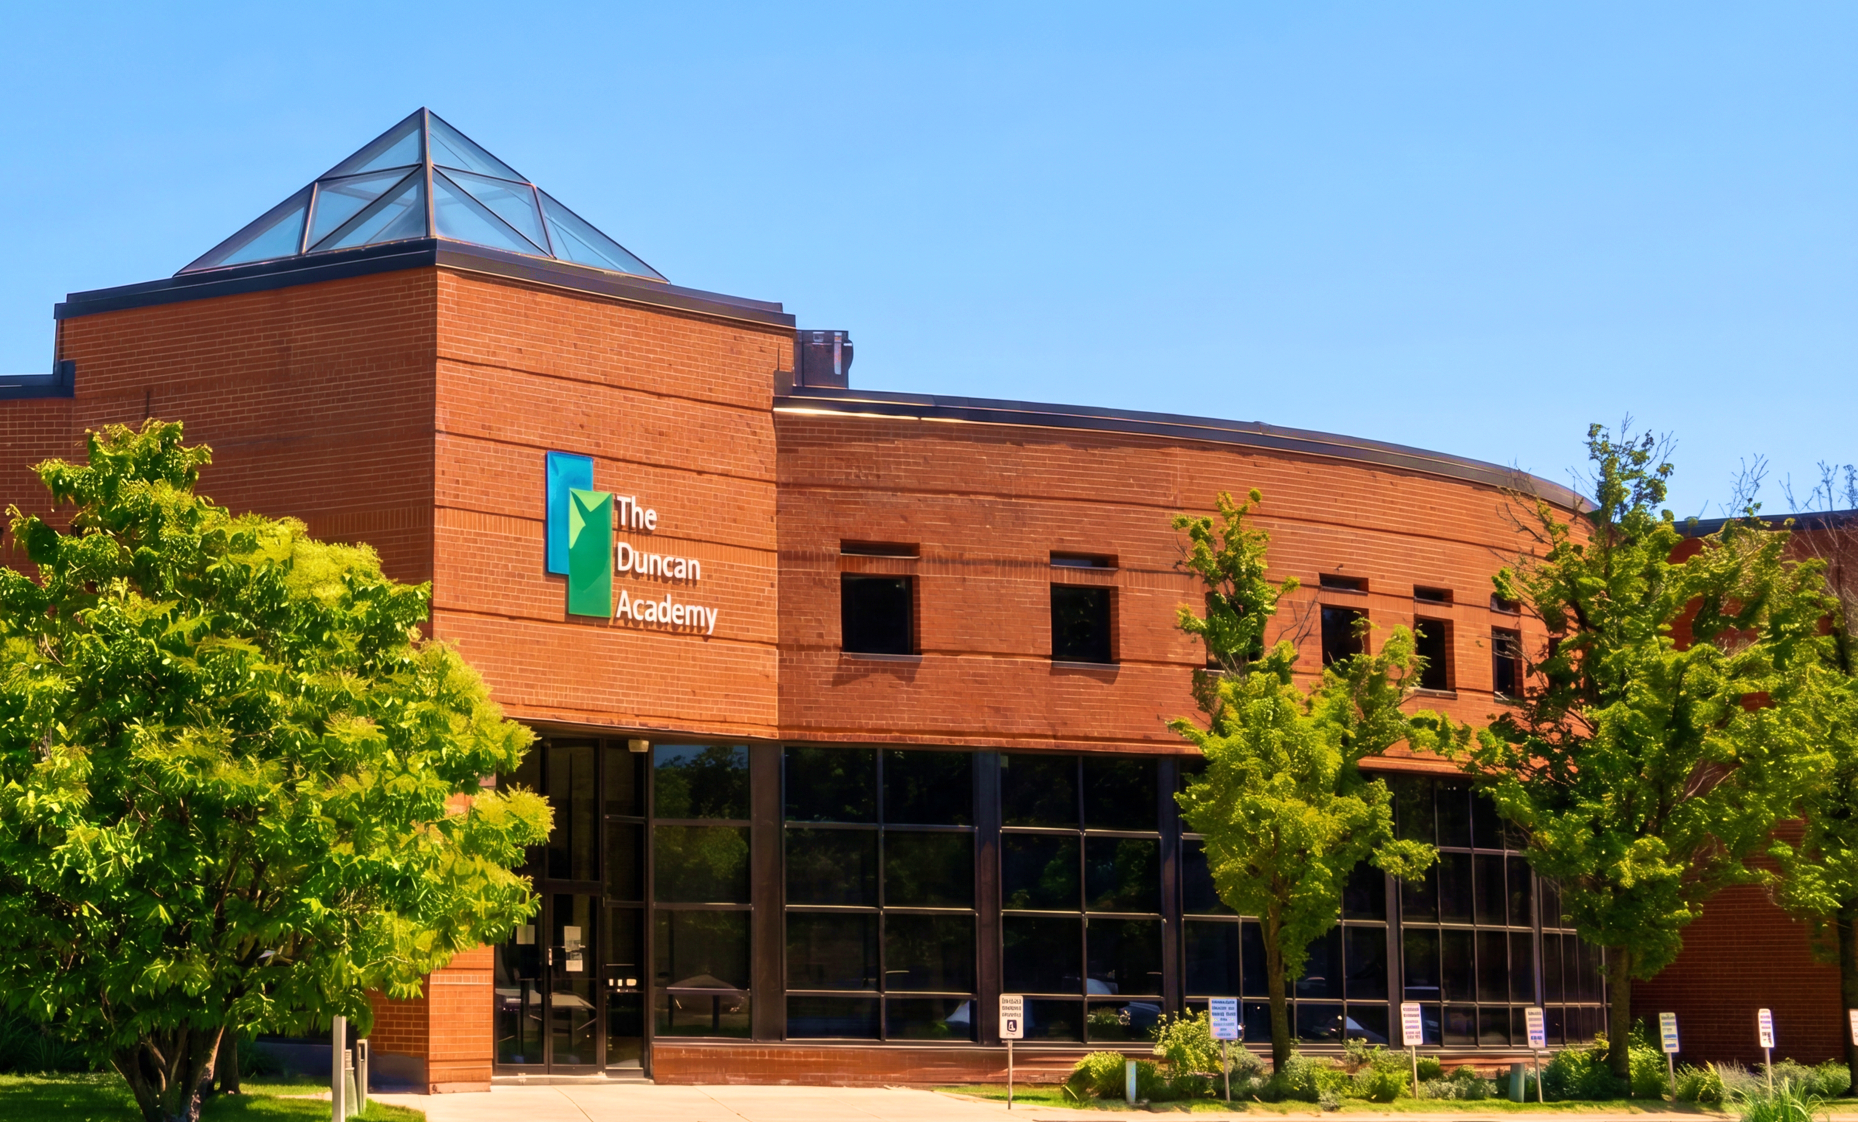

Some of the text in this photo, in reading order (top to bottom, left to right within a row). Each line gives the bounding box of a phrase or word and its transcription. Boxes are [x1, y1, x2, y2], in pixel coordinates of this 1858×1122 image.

[617, 496, 657, 530] The
[617, 541, 701, 580] Duncan
[616, 590, 718, 635] Academy
